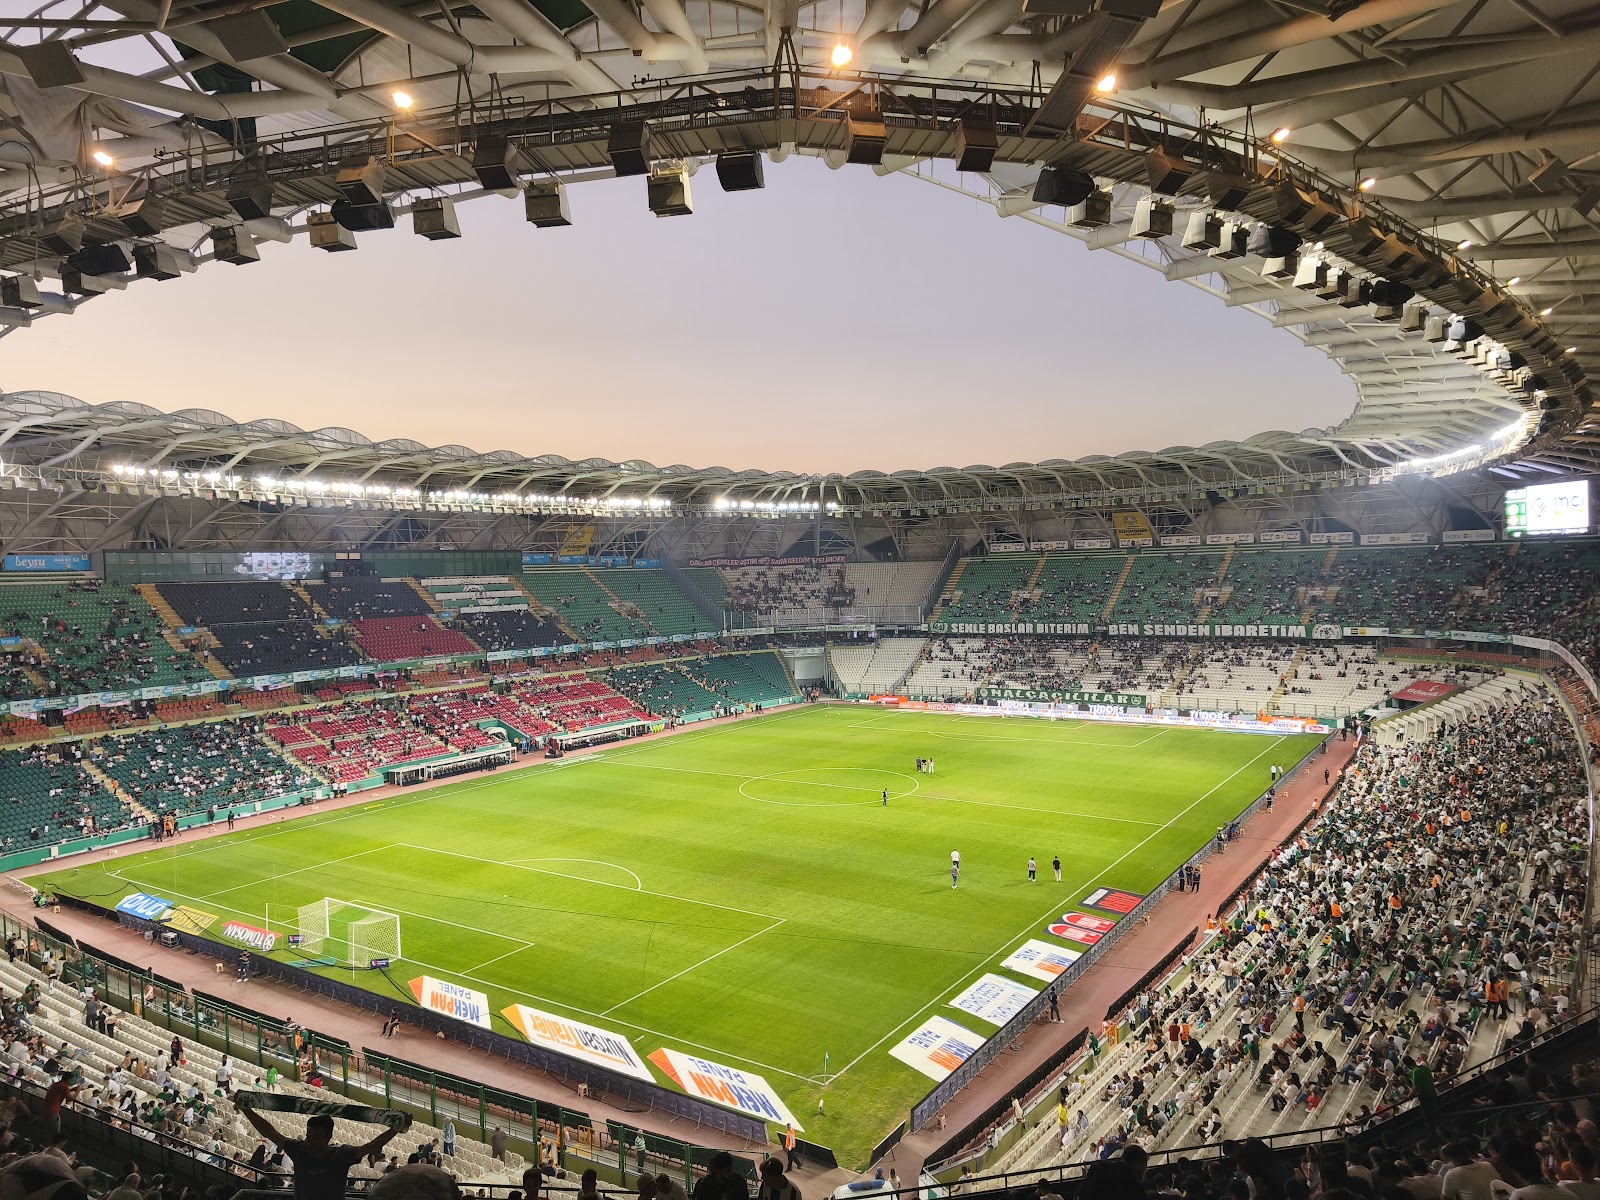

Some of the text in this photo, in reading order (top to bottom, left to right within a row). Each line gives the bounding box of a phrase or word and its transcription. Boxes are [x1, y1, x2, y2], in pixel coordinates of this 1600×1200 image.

[15, 556, 46, 569] beysu
[951, 623, 985, 634] SENLE
[1108, 624, 1139, 635] BEN
[1143, 624, 1210, 636] SENDEN
[997, 700, 1029, 709] TUDORS
[1088, 704, 1124, 714] TUDORS
[1189, 710, 1230, 720] TUDORS
[438, 981, 471, 1000] PANEL
[430, 990, 480, 1023] MEKPAN
[688, 1057, 746, 1084] PANEL
[688, 1070, 782, 1121] MEKPAN
[295, 1099, 347, 1116] 1922
